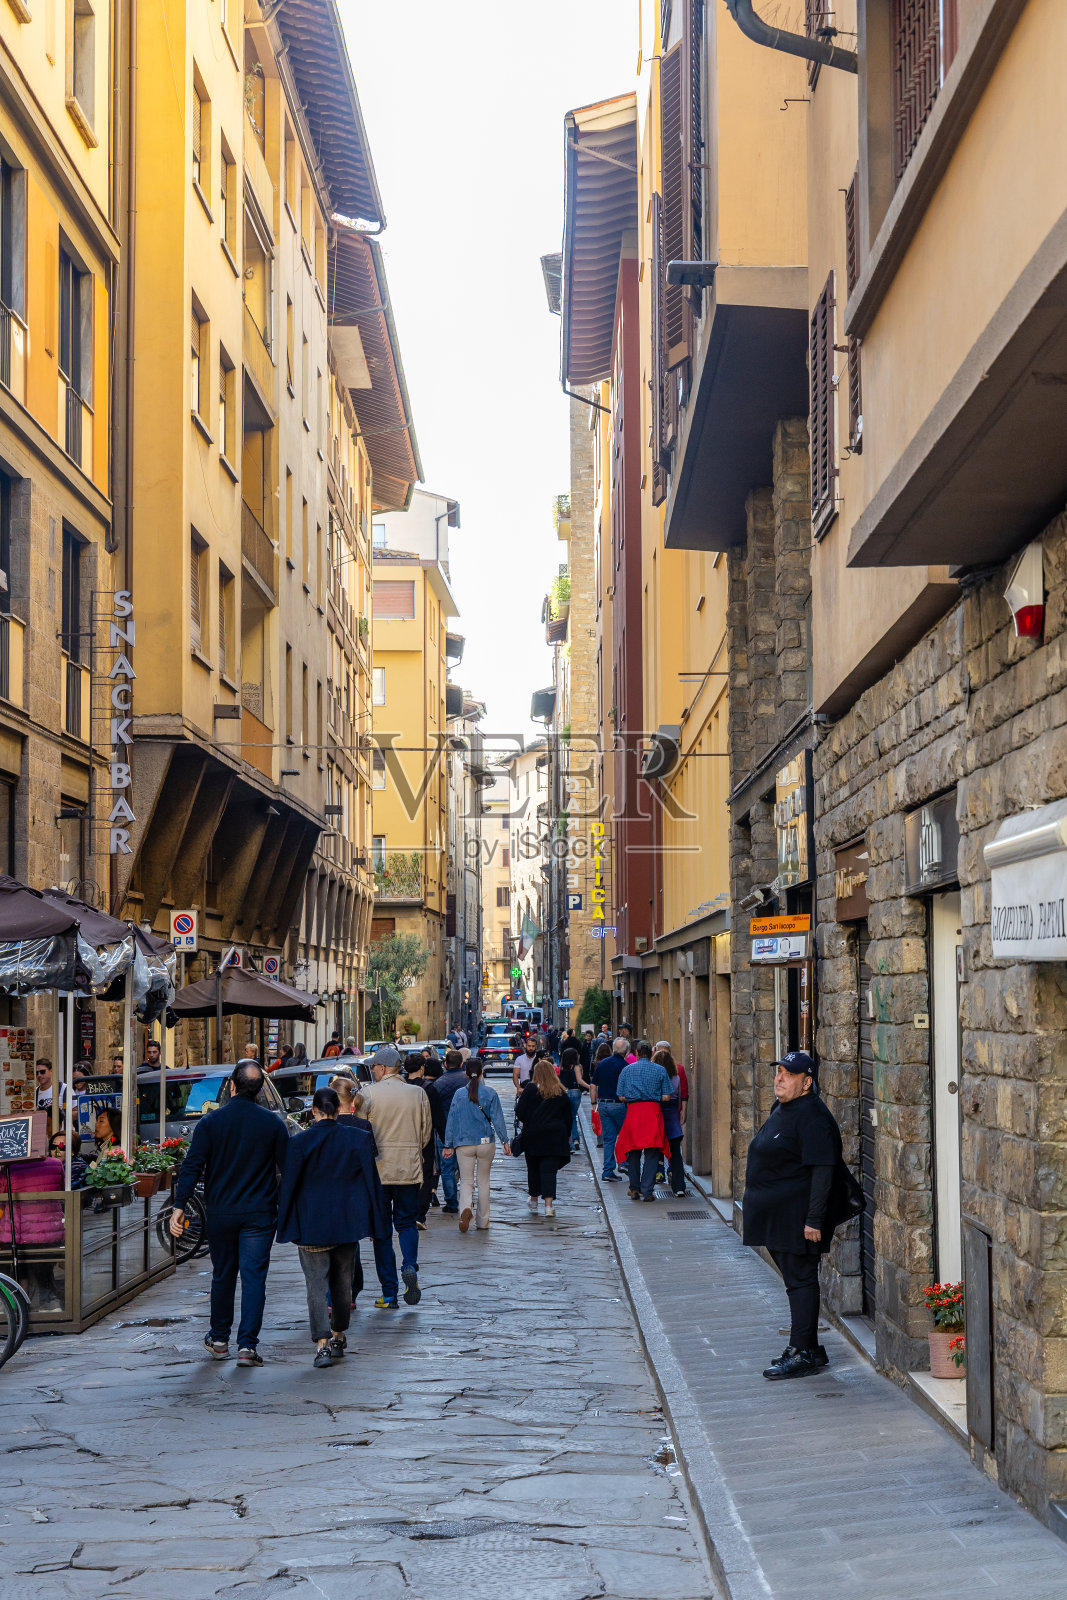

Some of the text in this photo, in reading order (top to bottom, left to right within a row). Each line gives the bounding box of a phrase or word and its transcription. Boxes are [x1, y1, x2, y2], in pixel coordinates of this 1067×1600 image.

[107, 589, 136, 855] SNACK BAR
[752, 924, 768, 933] Borgo
